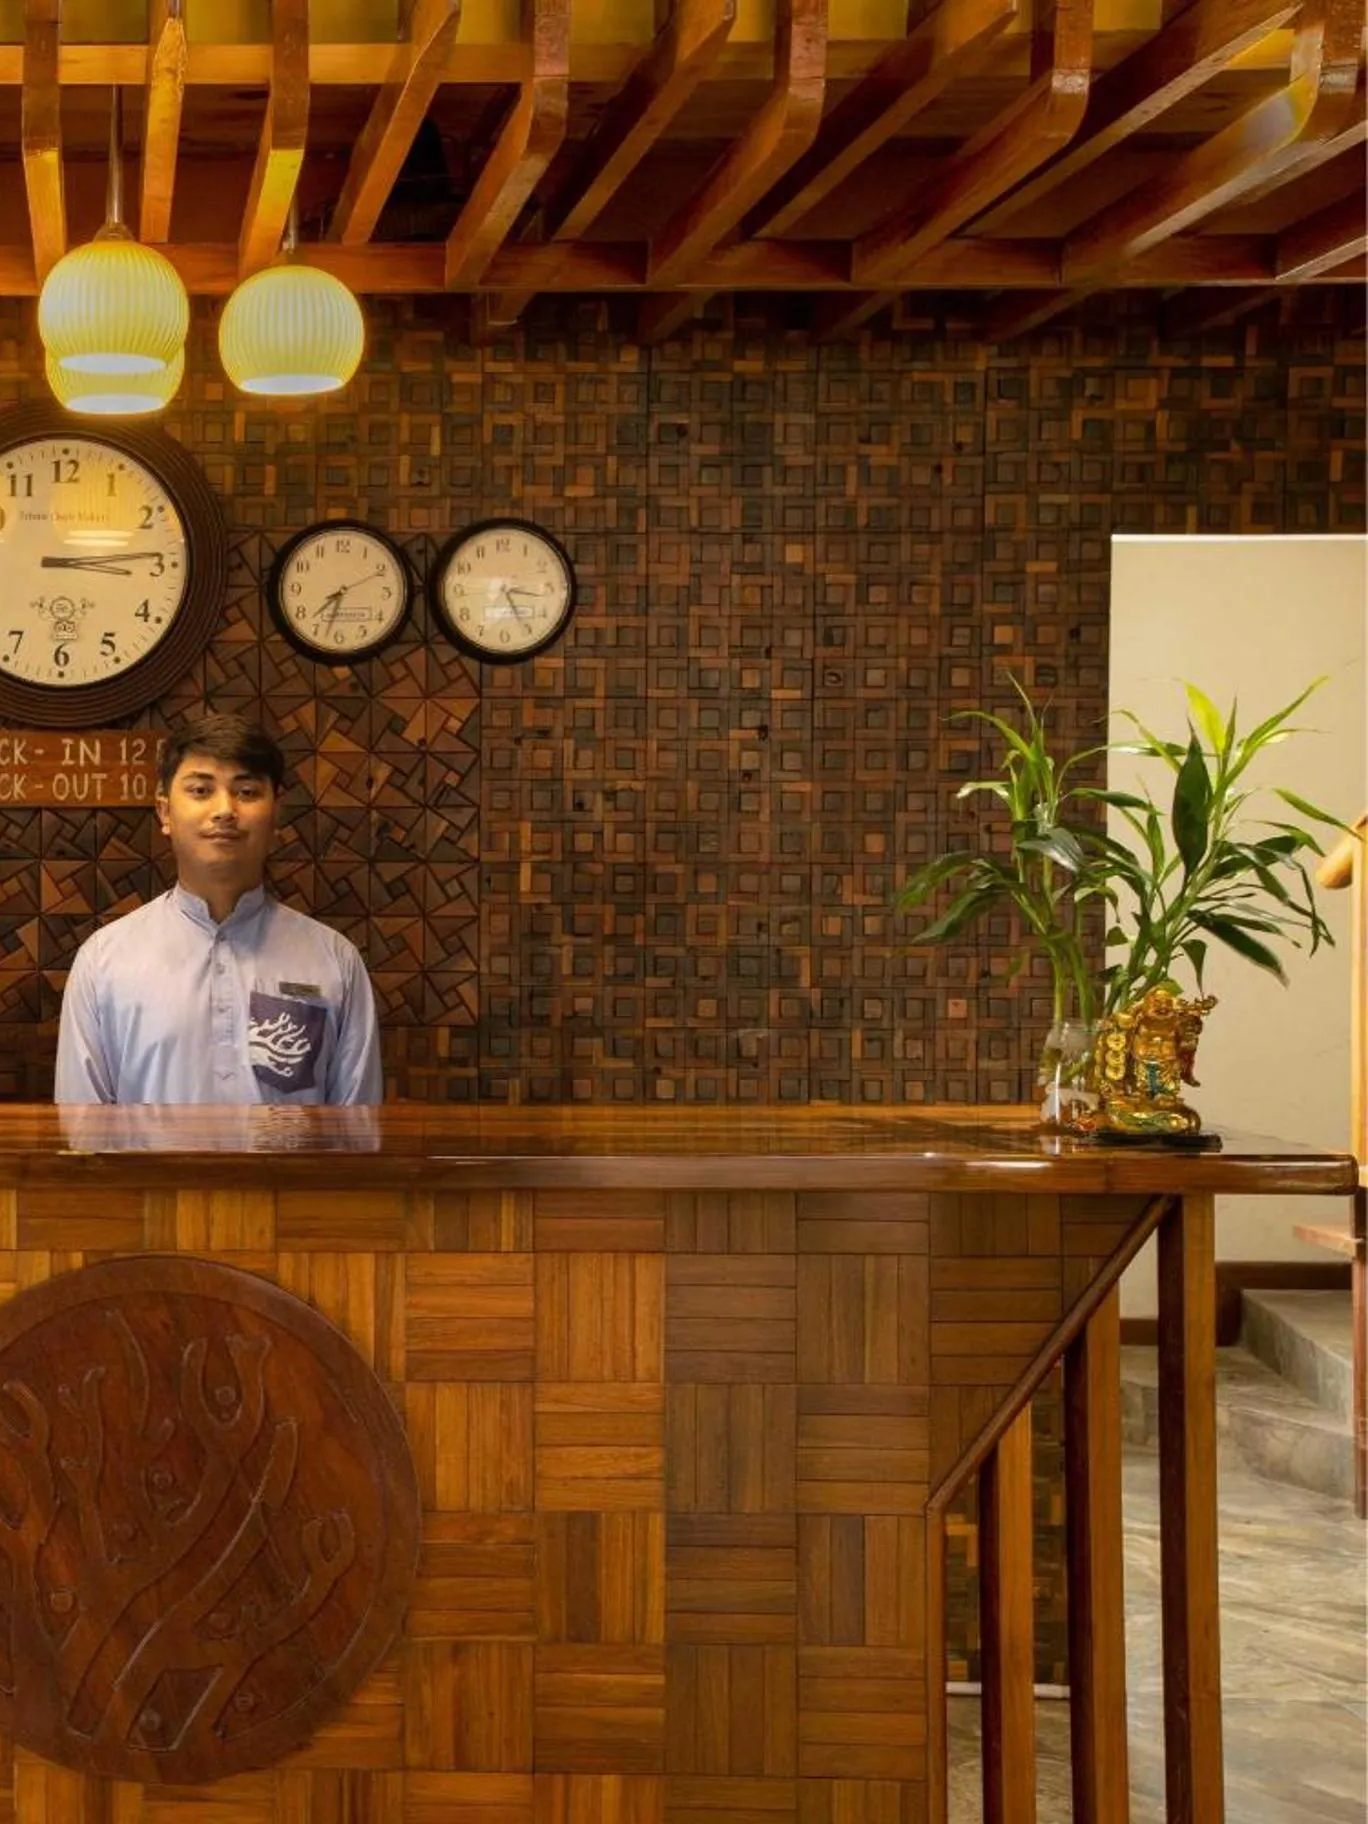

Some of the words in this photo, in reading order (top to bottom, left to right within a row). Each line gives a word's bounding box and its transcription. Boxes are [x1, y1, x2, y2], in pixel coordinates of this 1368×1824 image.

[51, 460, 80, 483] 12
[8, 474, 33, 497] 11
[106, 474, 116, 497] 1
[138, 505, 153, 529] 2
[316, 544, 324, 559] 11
[336, 539, 351, 553] 12
[363, 546, 368, 560] 1
[149, 553, 165, 577] 3
[296, 561, 310, 573] 10
[376, 563, 386, 577] 2
[290, 582, 302, 596] 9
[134, 599, 150, 622] 4
[295, 605, 306, 620] 8
[375, 609, 385, 624] 4
[312, 623, 320, 637] 7
[333, 631, 345, 644] 6
[8, 631, 24, 654] 7
[100, 632, 116, 656] 5
[54, 643, 70, 667] 6
[120, 772, 147, 800] 10
